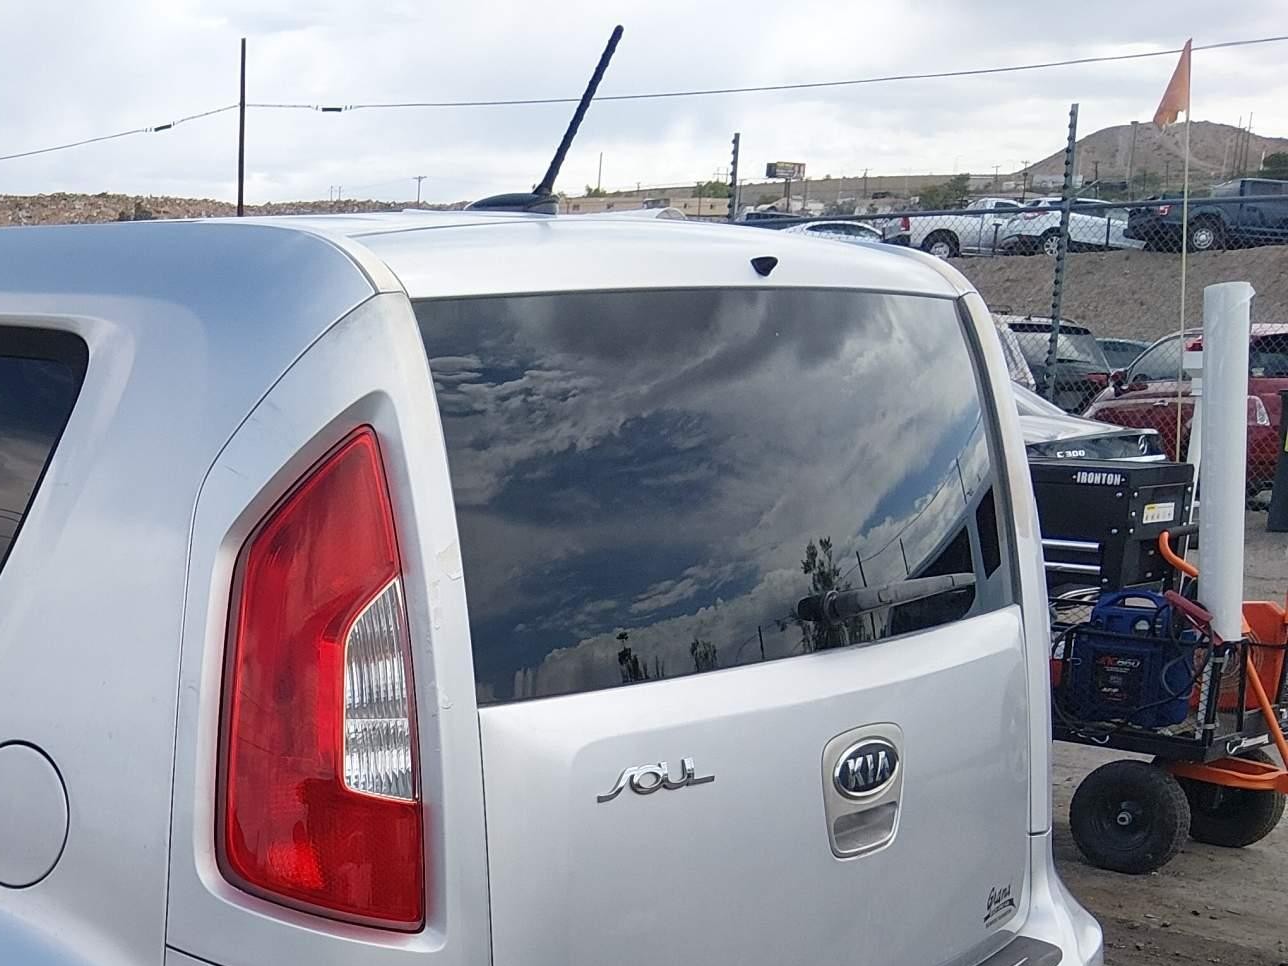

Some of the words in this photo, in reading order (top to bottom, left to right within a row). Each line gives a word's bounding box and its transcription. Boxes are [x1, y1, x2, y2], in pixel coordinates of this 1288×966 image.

[1065, 450, 1086, 458] 300
[1076, 471, 1122, 486] IRONTON
[597, 757, 715, 803] SOUL
[846, 750, 892, 790] KIA
